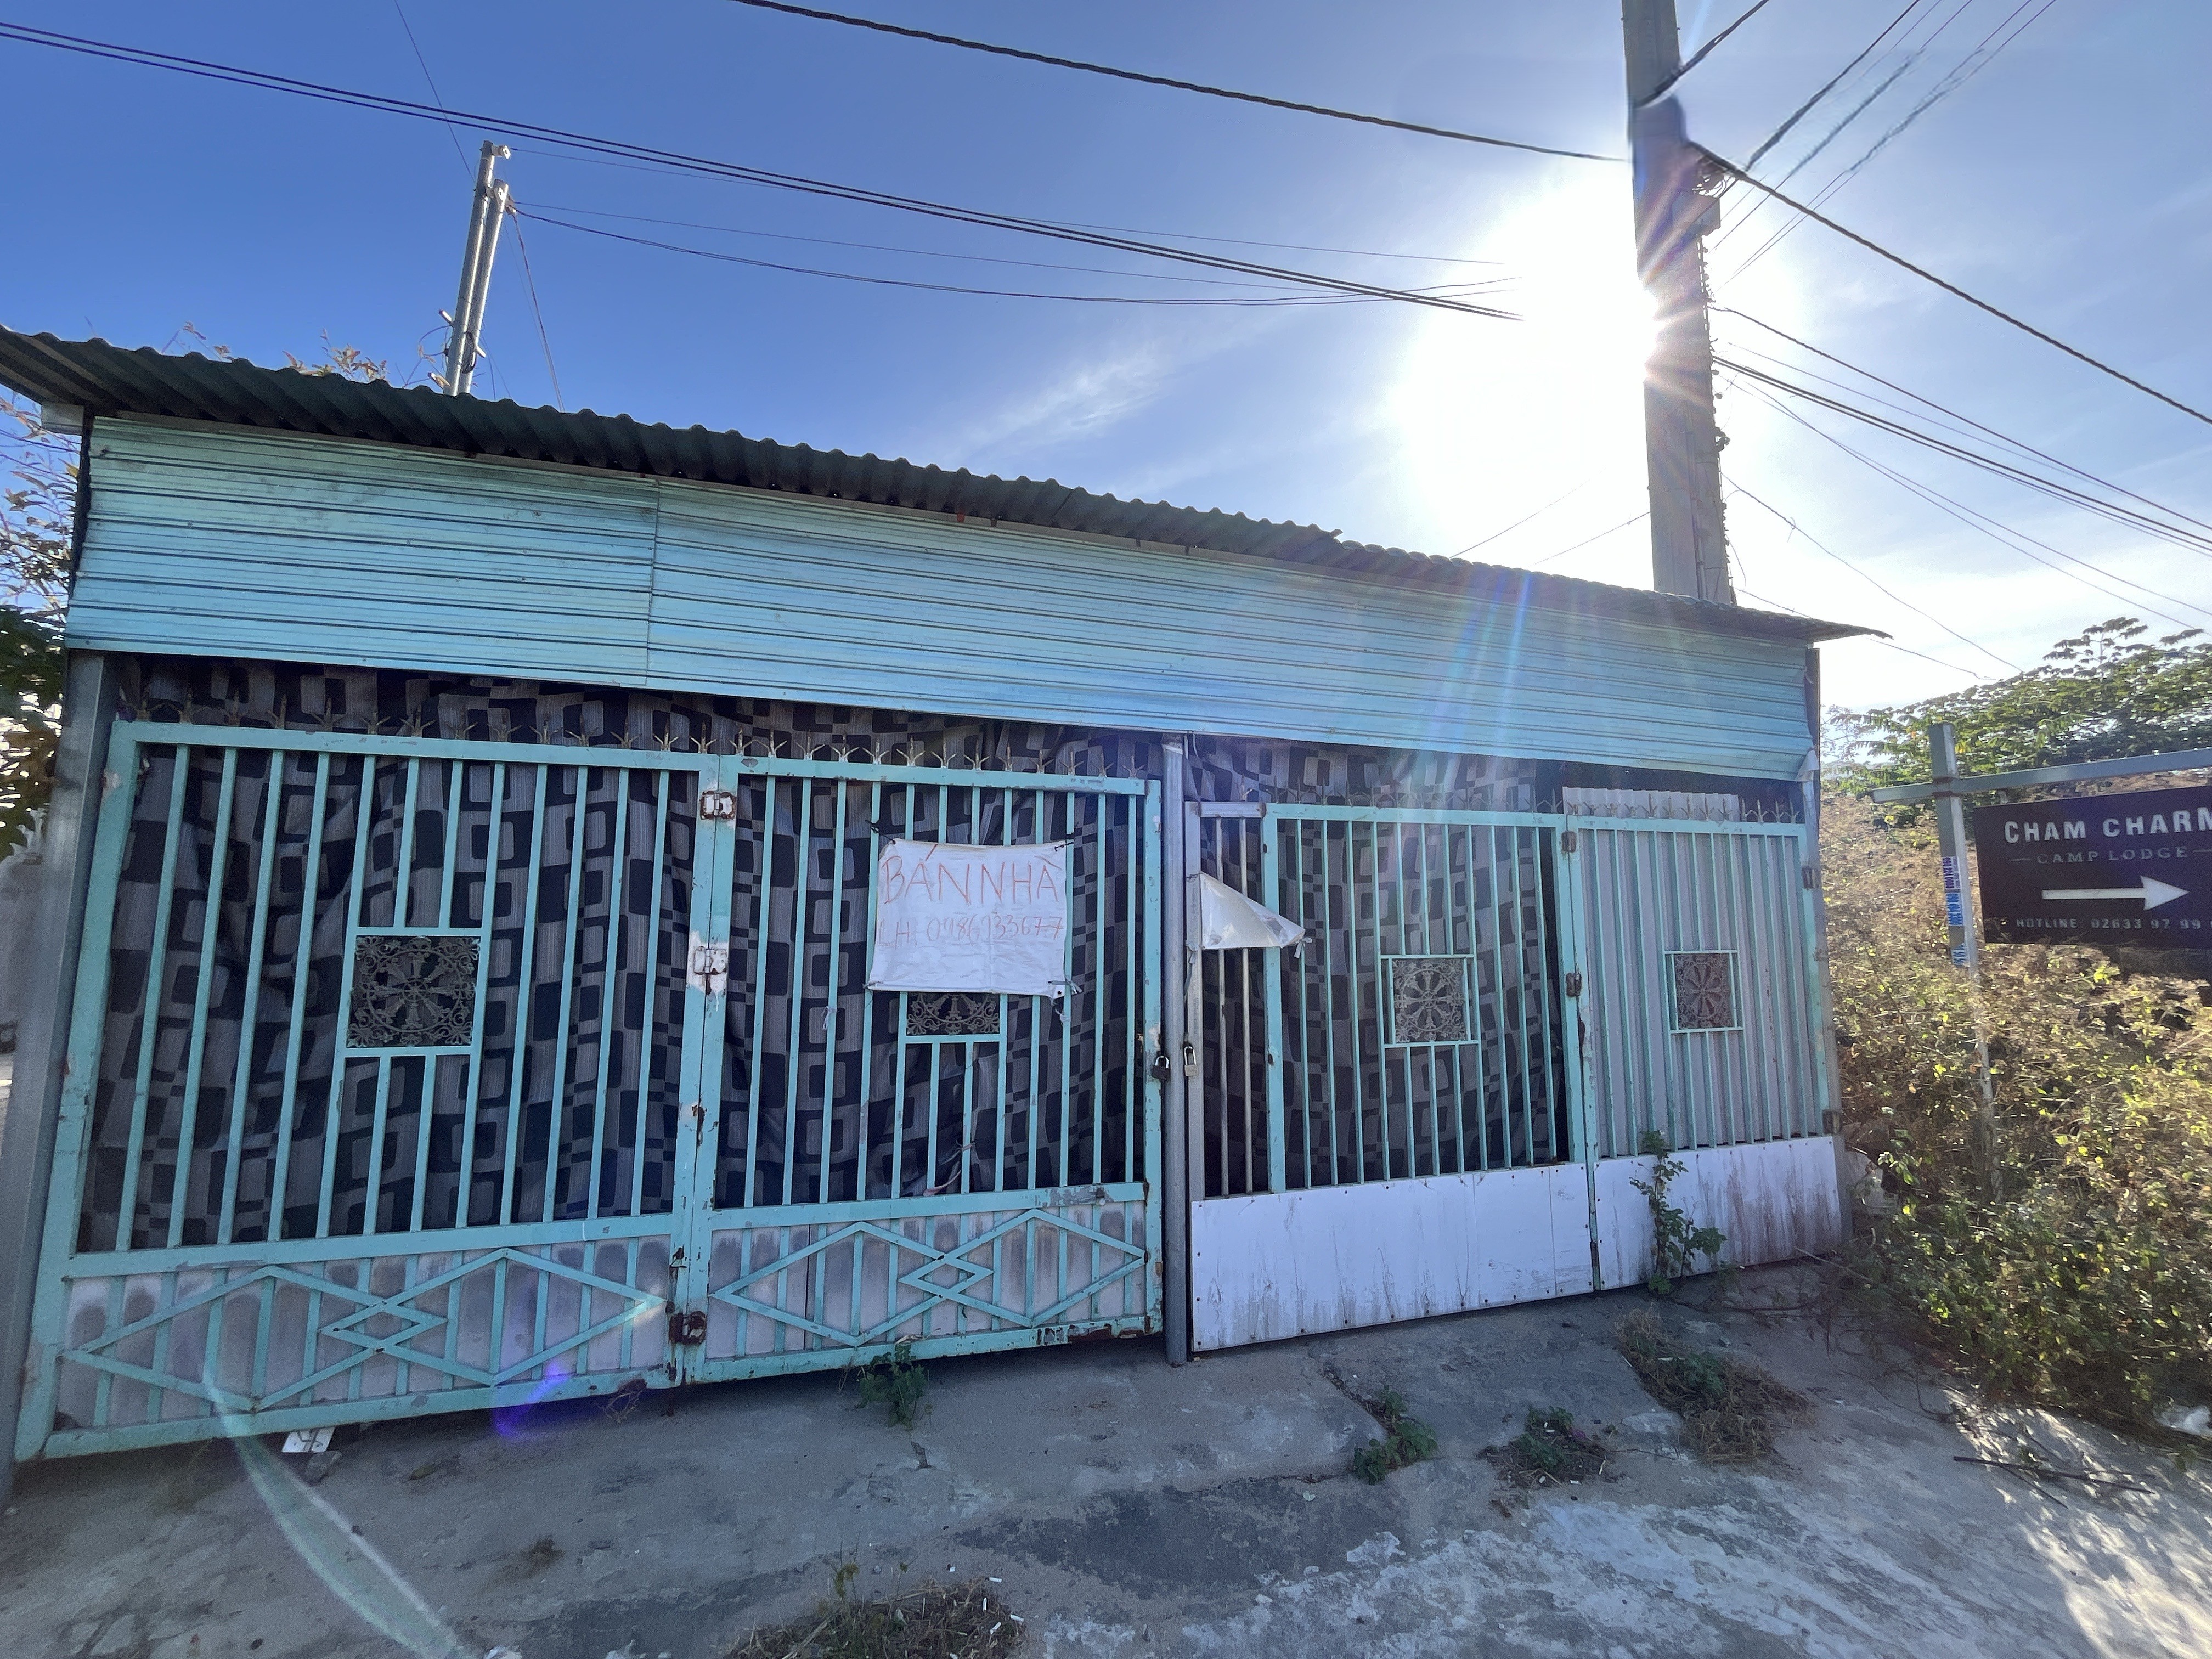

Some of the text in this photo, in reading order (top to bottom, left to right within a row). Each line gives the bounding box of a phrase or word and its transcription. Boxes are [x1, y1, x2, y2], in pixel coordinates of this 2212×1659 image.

[2004, 820, 2086, 843] CHAM
[2037, 847, 2188, 864] CAMP LODGE
[882, 844, 1063, 905] BÁN NHÀ
[2017, 918, 2078, 929] HOTLINE
[2151, 918, 2170, 929] 97
[2180, 918, 2201, 929] 99
